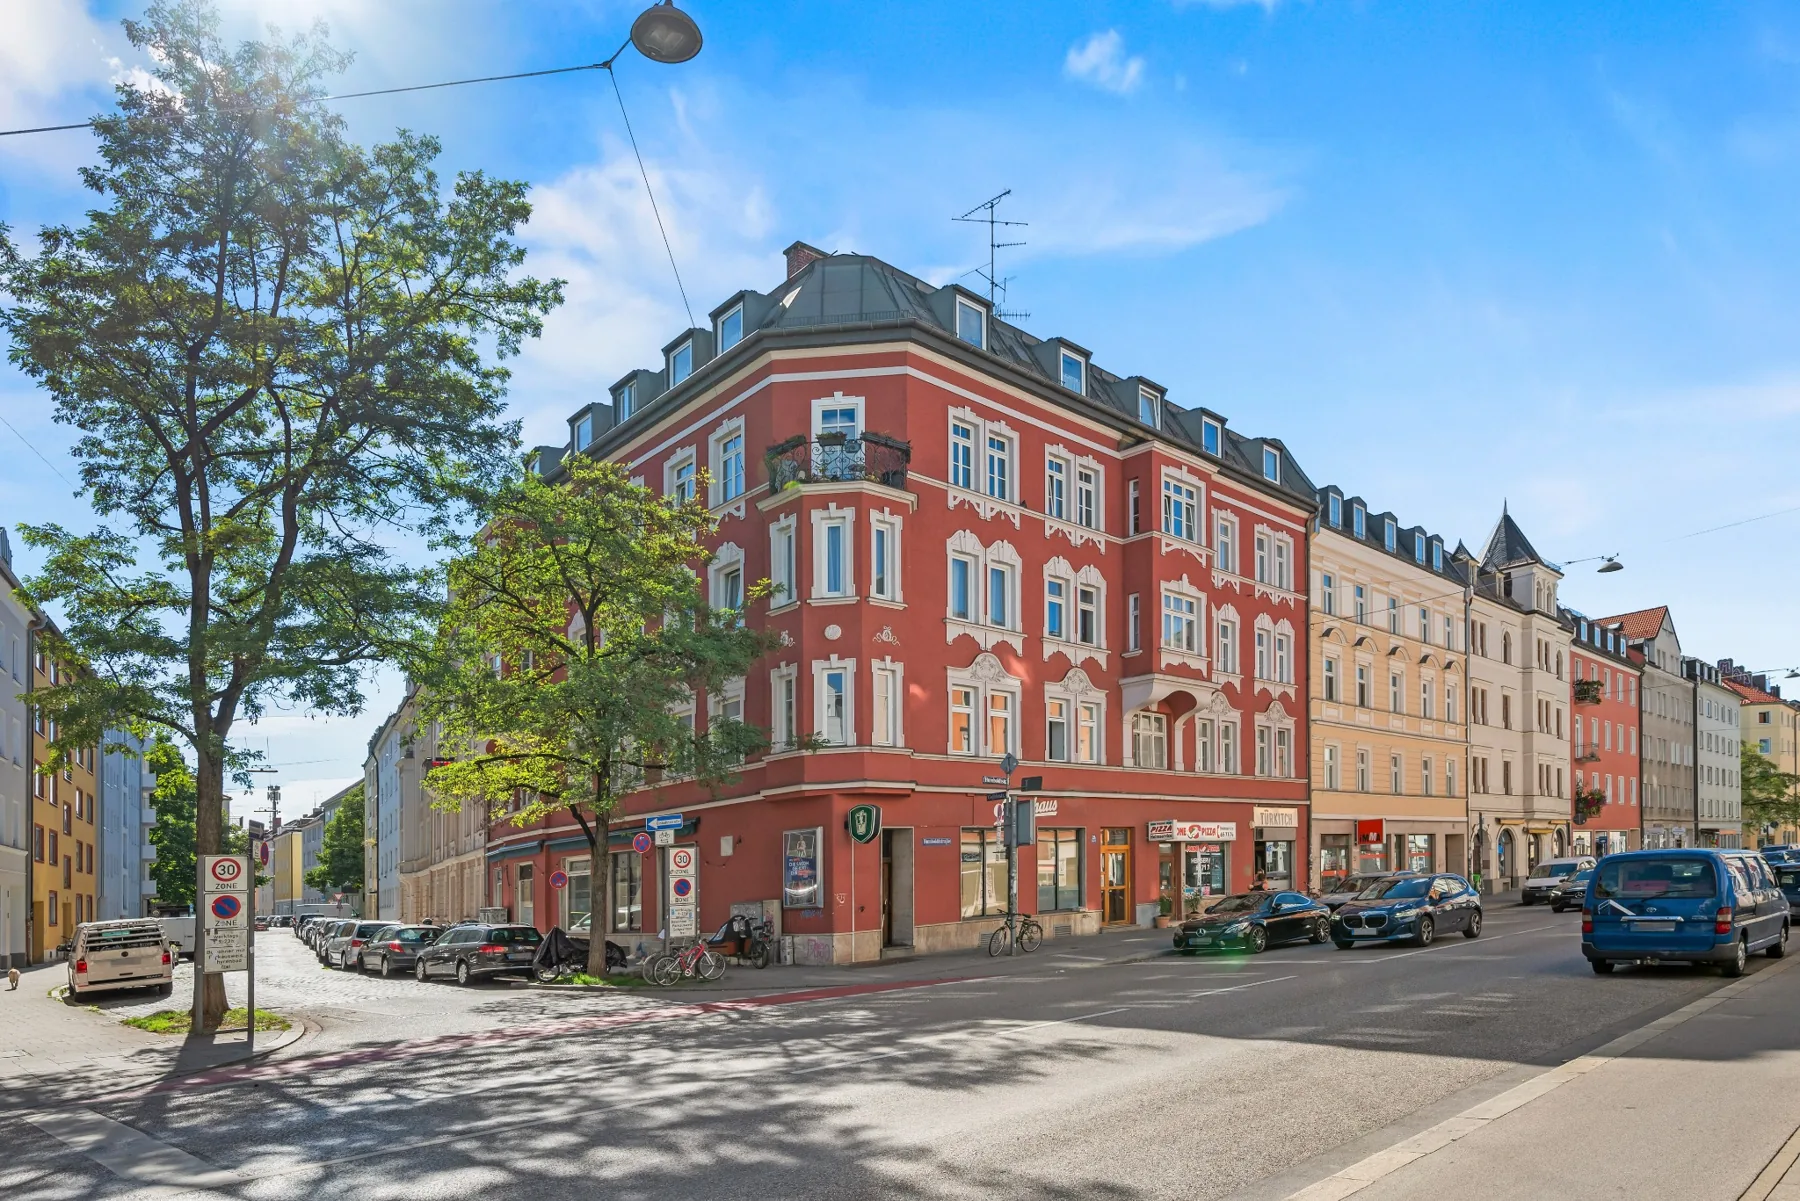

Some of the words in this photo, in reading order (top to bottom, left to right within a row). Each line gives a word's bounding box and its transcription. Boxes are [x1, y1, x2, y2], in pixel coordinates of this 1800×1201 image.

[1150, 824, 1173, 833] PIZZA
[1201, 827, 1216, 836] PIZZA
[677, 854, 688, 864] 30
[217, 864, 236, 876] 30
[215, 882, 238, 890] ZONE
